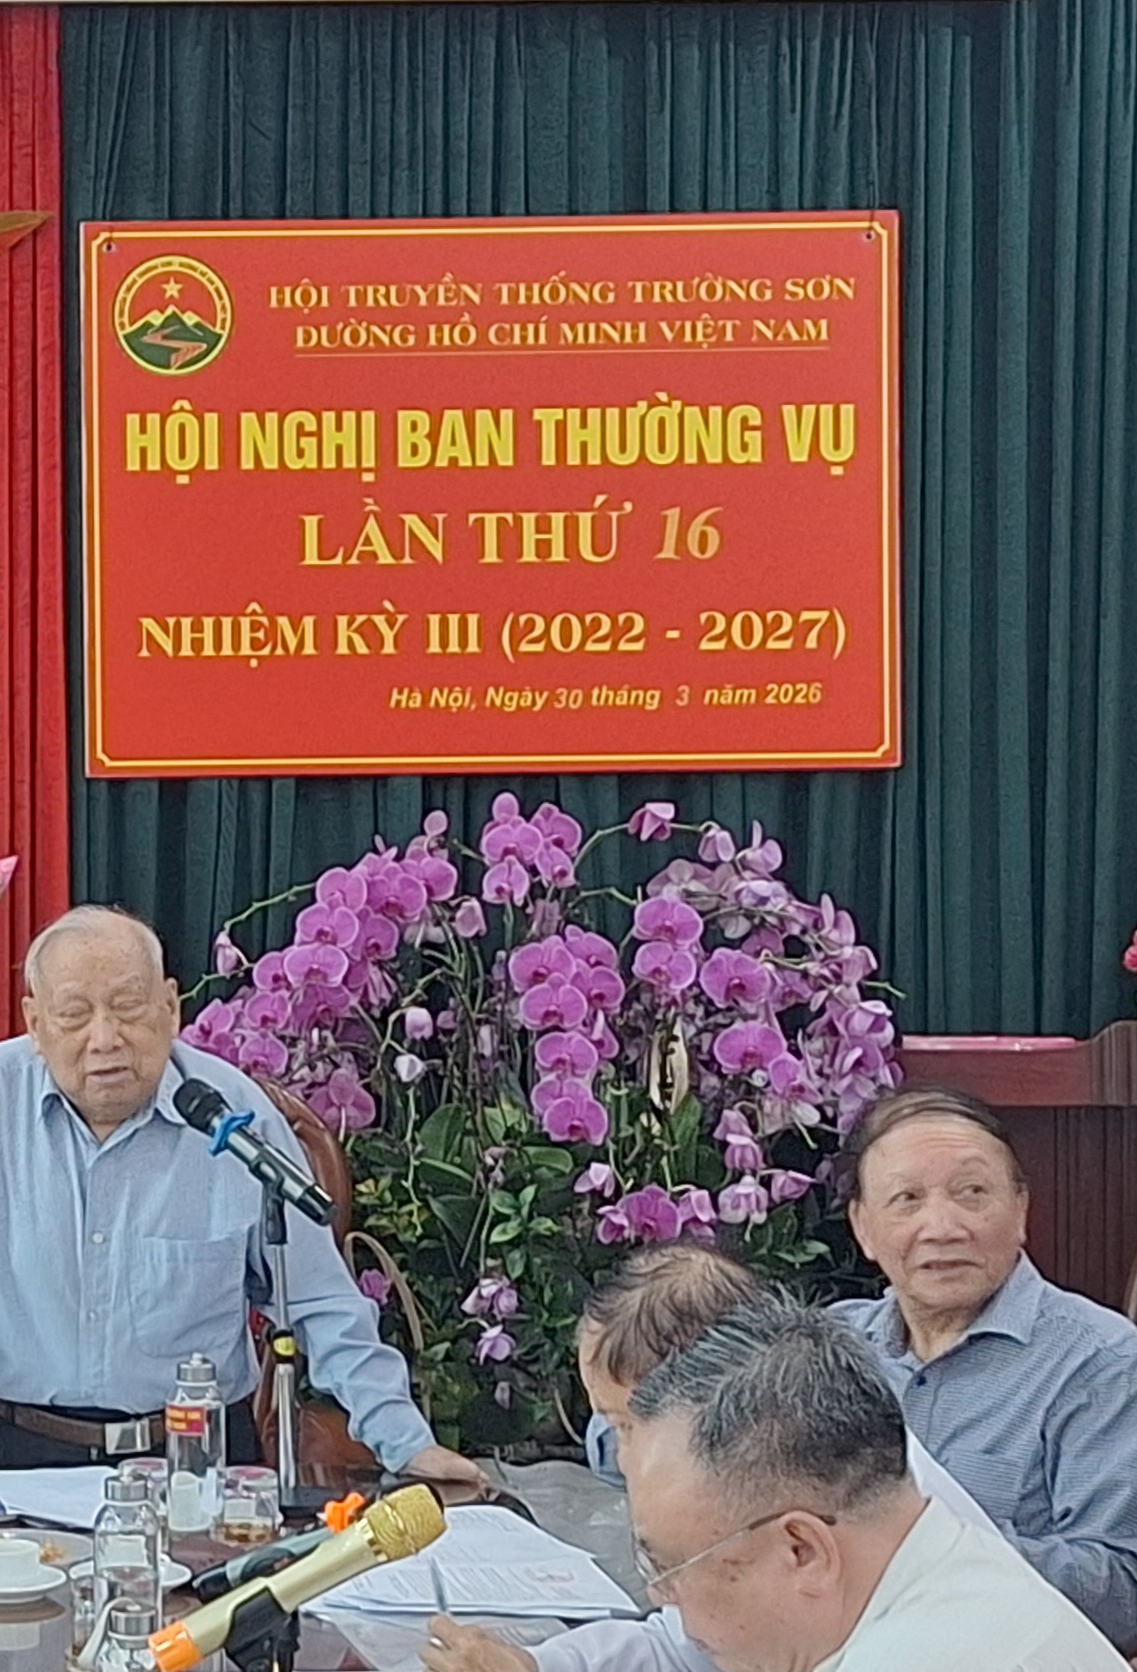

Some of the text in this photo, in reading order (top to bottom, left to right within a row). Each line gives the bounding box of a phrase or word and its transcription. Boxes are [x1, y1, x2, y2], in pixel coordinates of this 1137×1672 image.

[269, 276, 330, 315] HỘI
[341, 271, 482, 307] TRUYỀN
[495, 270, 615, 306] THỐNG
[627, 271, 773, 304] TRƯỜNG
[784, 274, 856, 301] SƠN
[427, 311, 477, 347] HỒ
[487, 315, 548, 346] CHÍ
[558, 320, 647, 345] MINH
[658, 313, 740, 350] VIỆT
[751, 318, 830, 342] NAM
[124, 391, 855, 485] HỘI NGHỊ BAN THƯỜNG VỤ
[298, 493, 725, 566] LẦN THỨ 16
[137, 600, 319, 669] NHIỆM
[334, 599, 409, 656] KỲ
[425, 612, 483, 655] III
[500, 610, 647, 664] (2022
[697, 607, 847, 661] 2027)
[389, 682, 824, 713] Hà Nội, Ngày 30 tháng 3 năm 2026
